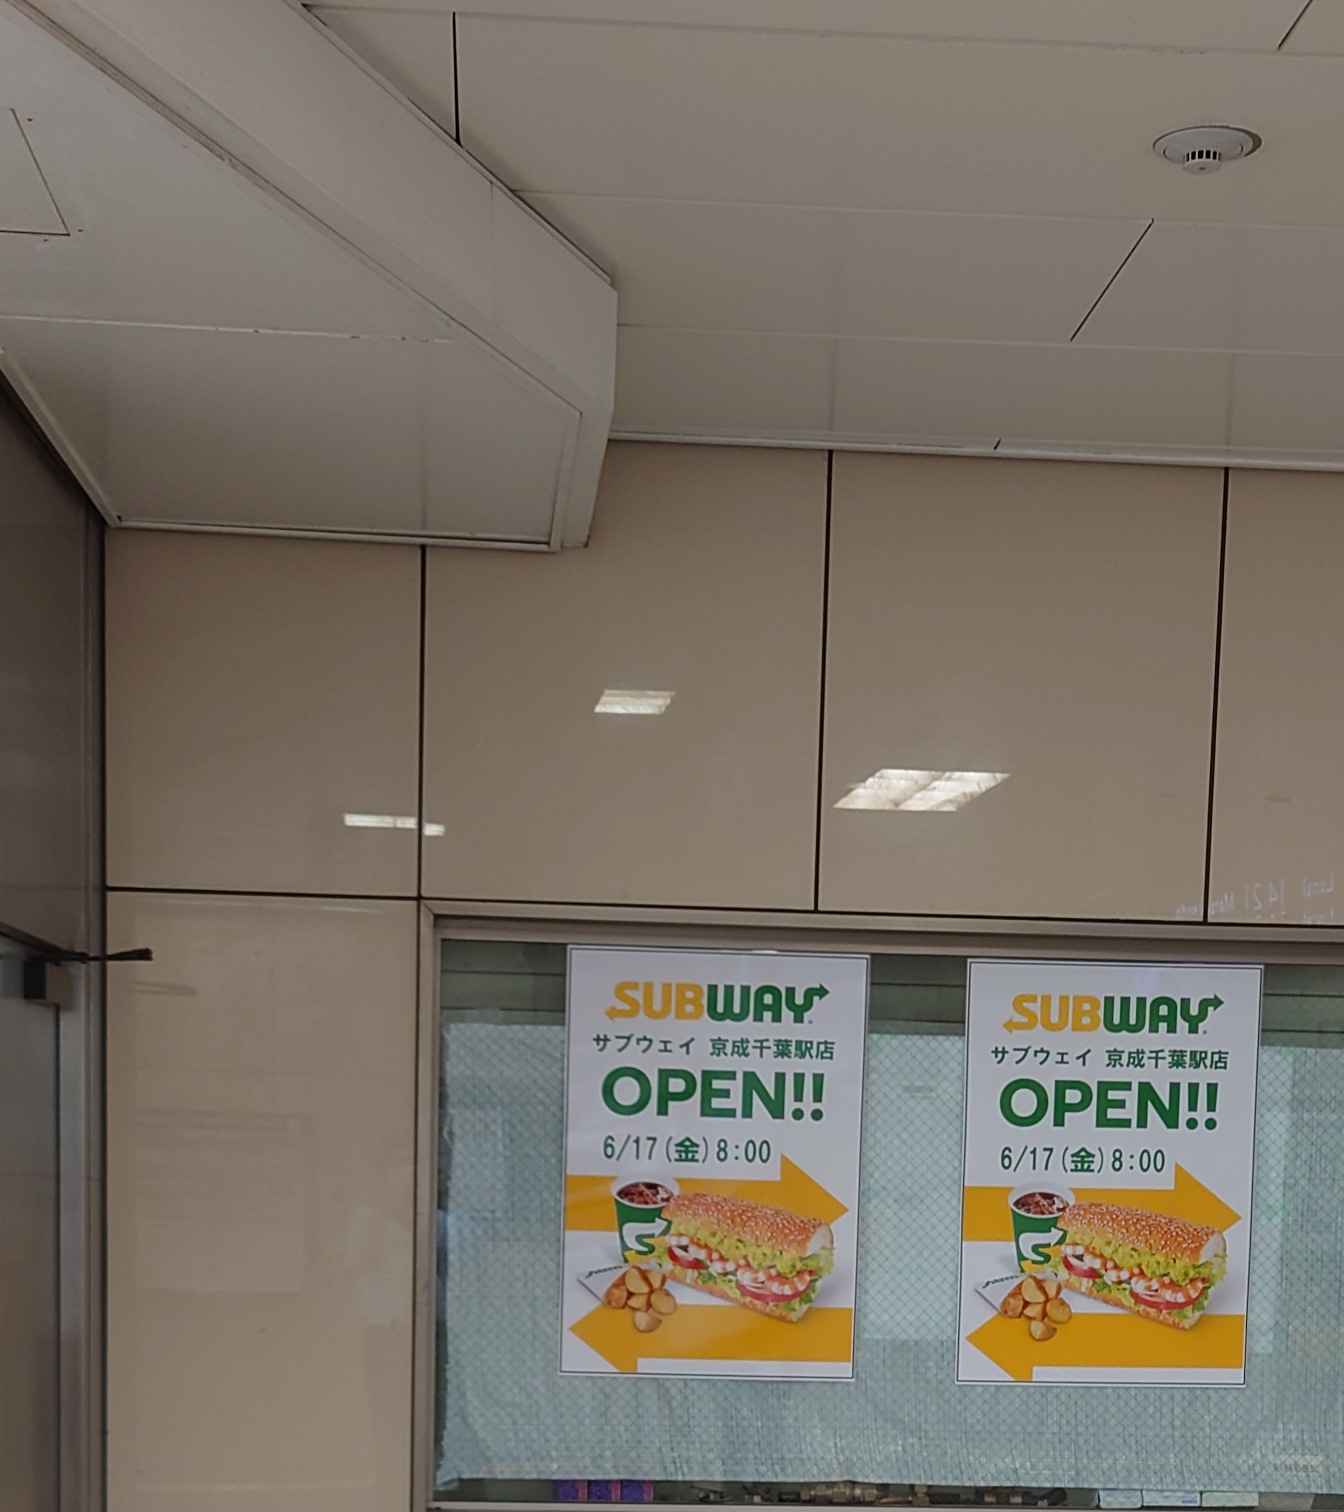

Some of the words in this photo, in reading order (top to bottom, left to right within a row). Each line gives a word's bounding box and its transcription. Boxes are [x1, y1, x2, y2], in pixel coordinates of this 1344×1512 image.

[605, 981, 830, 1024] SUBWAY
[1003, 992, 1225, 1036] SUBWAY
[592, 1034, 696, 1057] サブウェイ
[709, 1037, 835, 1061] 京成千葉駅店
[991, 1045, 1093, 1068] サブウェイ
[1105, 1047, 1230, 1072] 京成千葉駅店
[601, 1066, 824, 1122] OPEN!!
[999, 1077, 1219, 1131] OPEN!!
